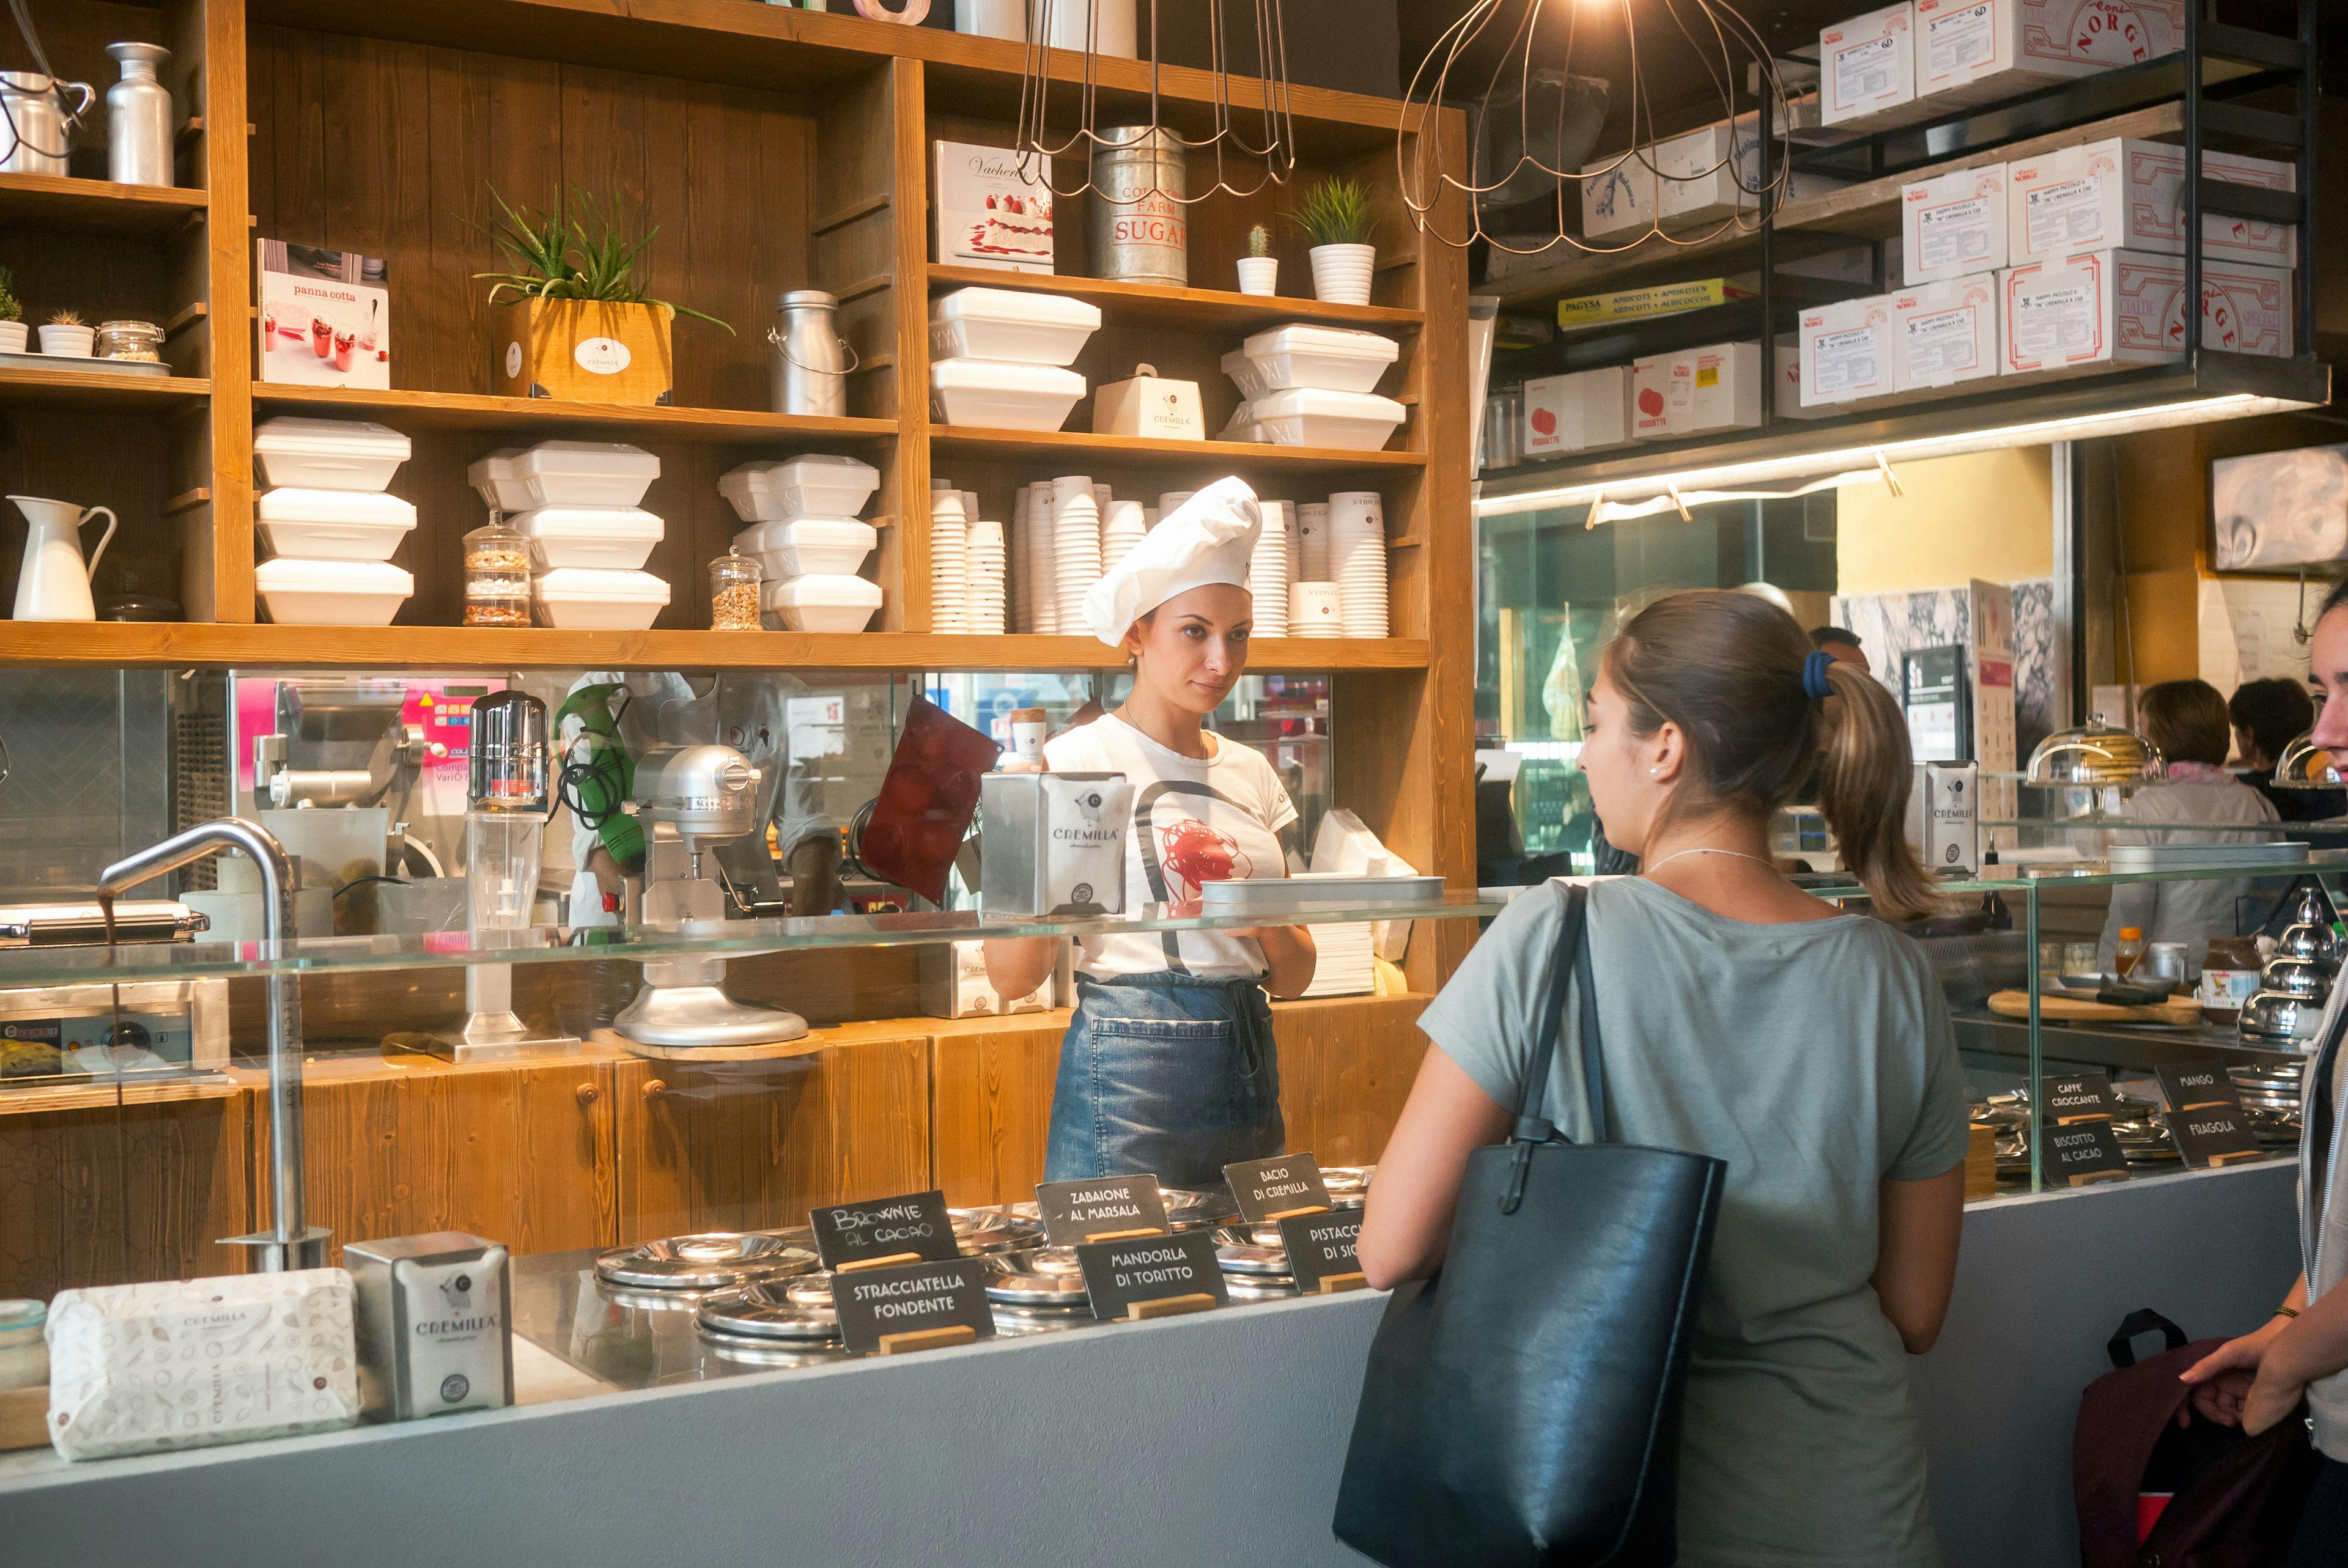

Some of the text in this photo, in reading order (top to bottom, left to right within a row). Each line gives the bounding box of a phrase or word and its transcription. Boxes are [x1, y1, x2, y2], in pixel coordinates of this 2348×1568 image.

[2077, 13, 2146, 63] NORGE
[1137, 201, 1175, 215] FARM
[1115, 221, 1186, 246] SUGAR
[294, 285, 327, 298] panna
[330, 290, 356, 303] cotta
[1154, 416, 1190, 425] CREMILLA
[1054, 829, 1117, 841] CREMILLA
[2180, 1074, 2213, 1087] MANGO
[2052, 1094, 2100, 1106] CROCCANTE
[2189, 1120, 2235, 1136] FRAGOLA
[2054, 1133, 2095, 1147] BISCOTTO
[2061, 1148, 2102, 1163] AL CACAO
[1260, 1168, 1289, 1182] BACIO
[1070, 1188, 1131, 1204] ZABAIONE
[1253, 1181, 1310, 1201] DI CREMILLA
[830, 1204, 921, 1231] BROWNIE
[1071, 1204, 1141, 1221] AL MARSALA
[844, 1223, 933, 1248] AL CACAO
[1112, 1246, 1187, 1268] MANDORLA
[1323, 1246, 1338, 1260] DI
[1115, 1266, 1193, 1287] DI TORITTO
[854, 1274, 965, 1301] STRACCIATELLA
[874, 1295, 955, 1319] FONDENTE
[183, 1312, 247, 1327] CREMILLA
[416, 1316, 497, 1335] CREMILLA
[212, 1364, 224, 1424] CREMILLA
